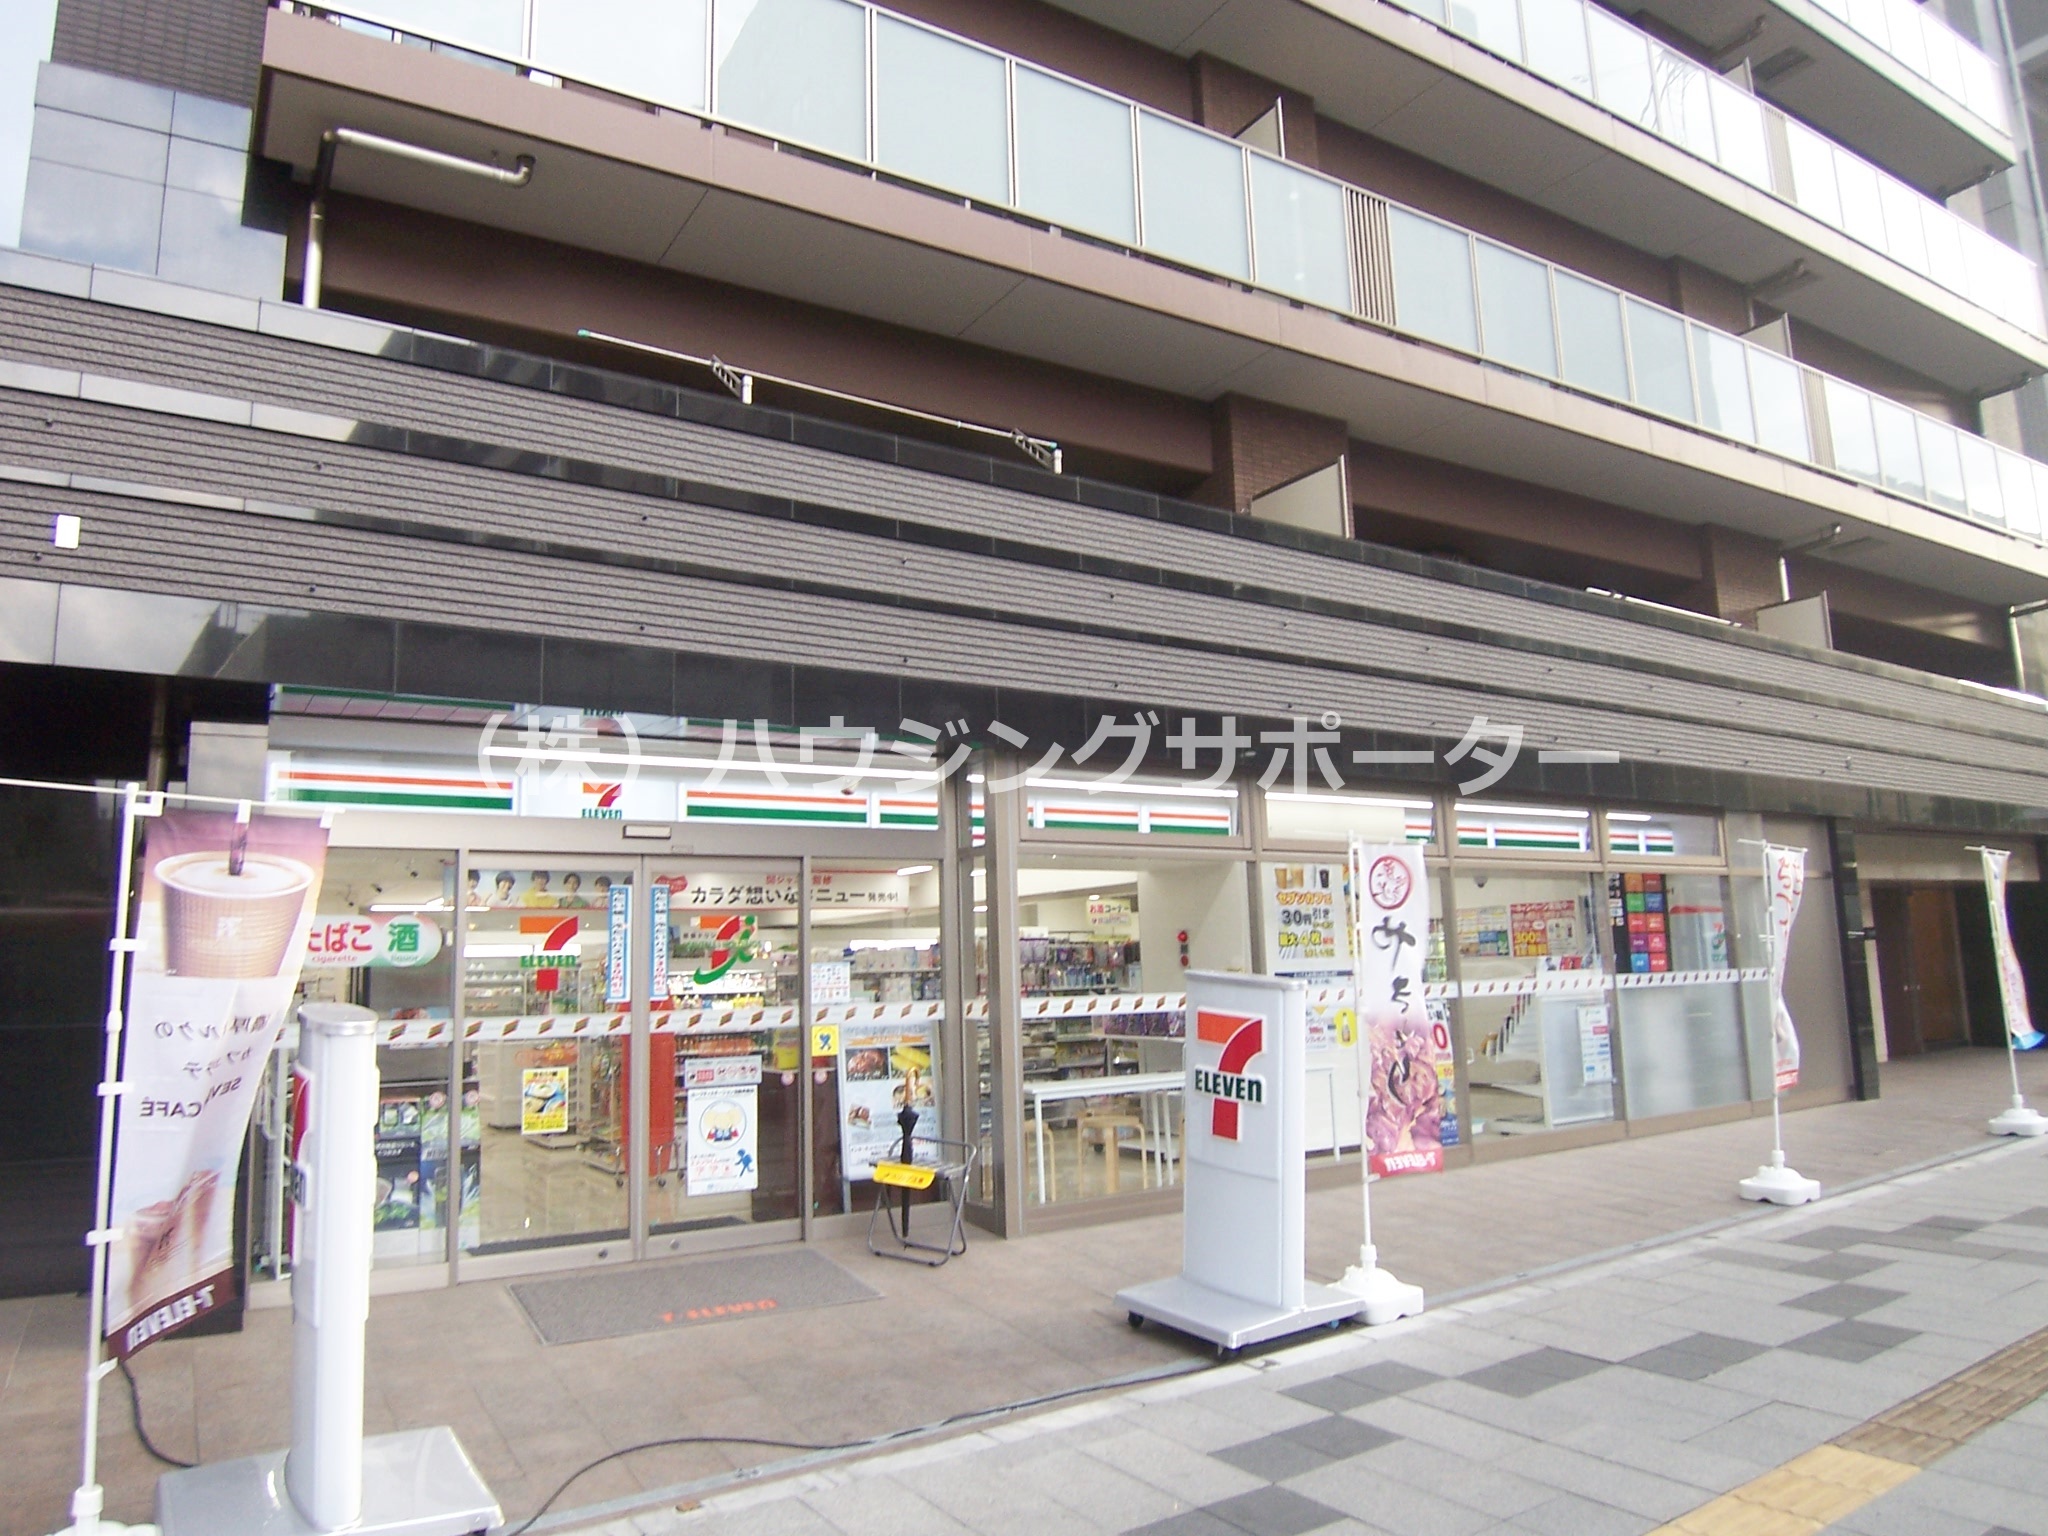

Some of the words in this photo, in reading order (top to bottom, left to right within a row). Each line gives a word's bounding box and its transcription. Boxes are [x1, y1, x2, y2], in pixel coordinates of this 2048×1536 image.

[691, 885, 866, 905] カラダ想いなニュー
[388, 922, 421, 952] 酒
